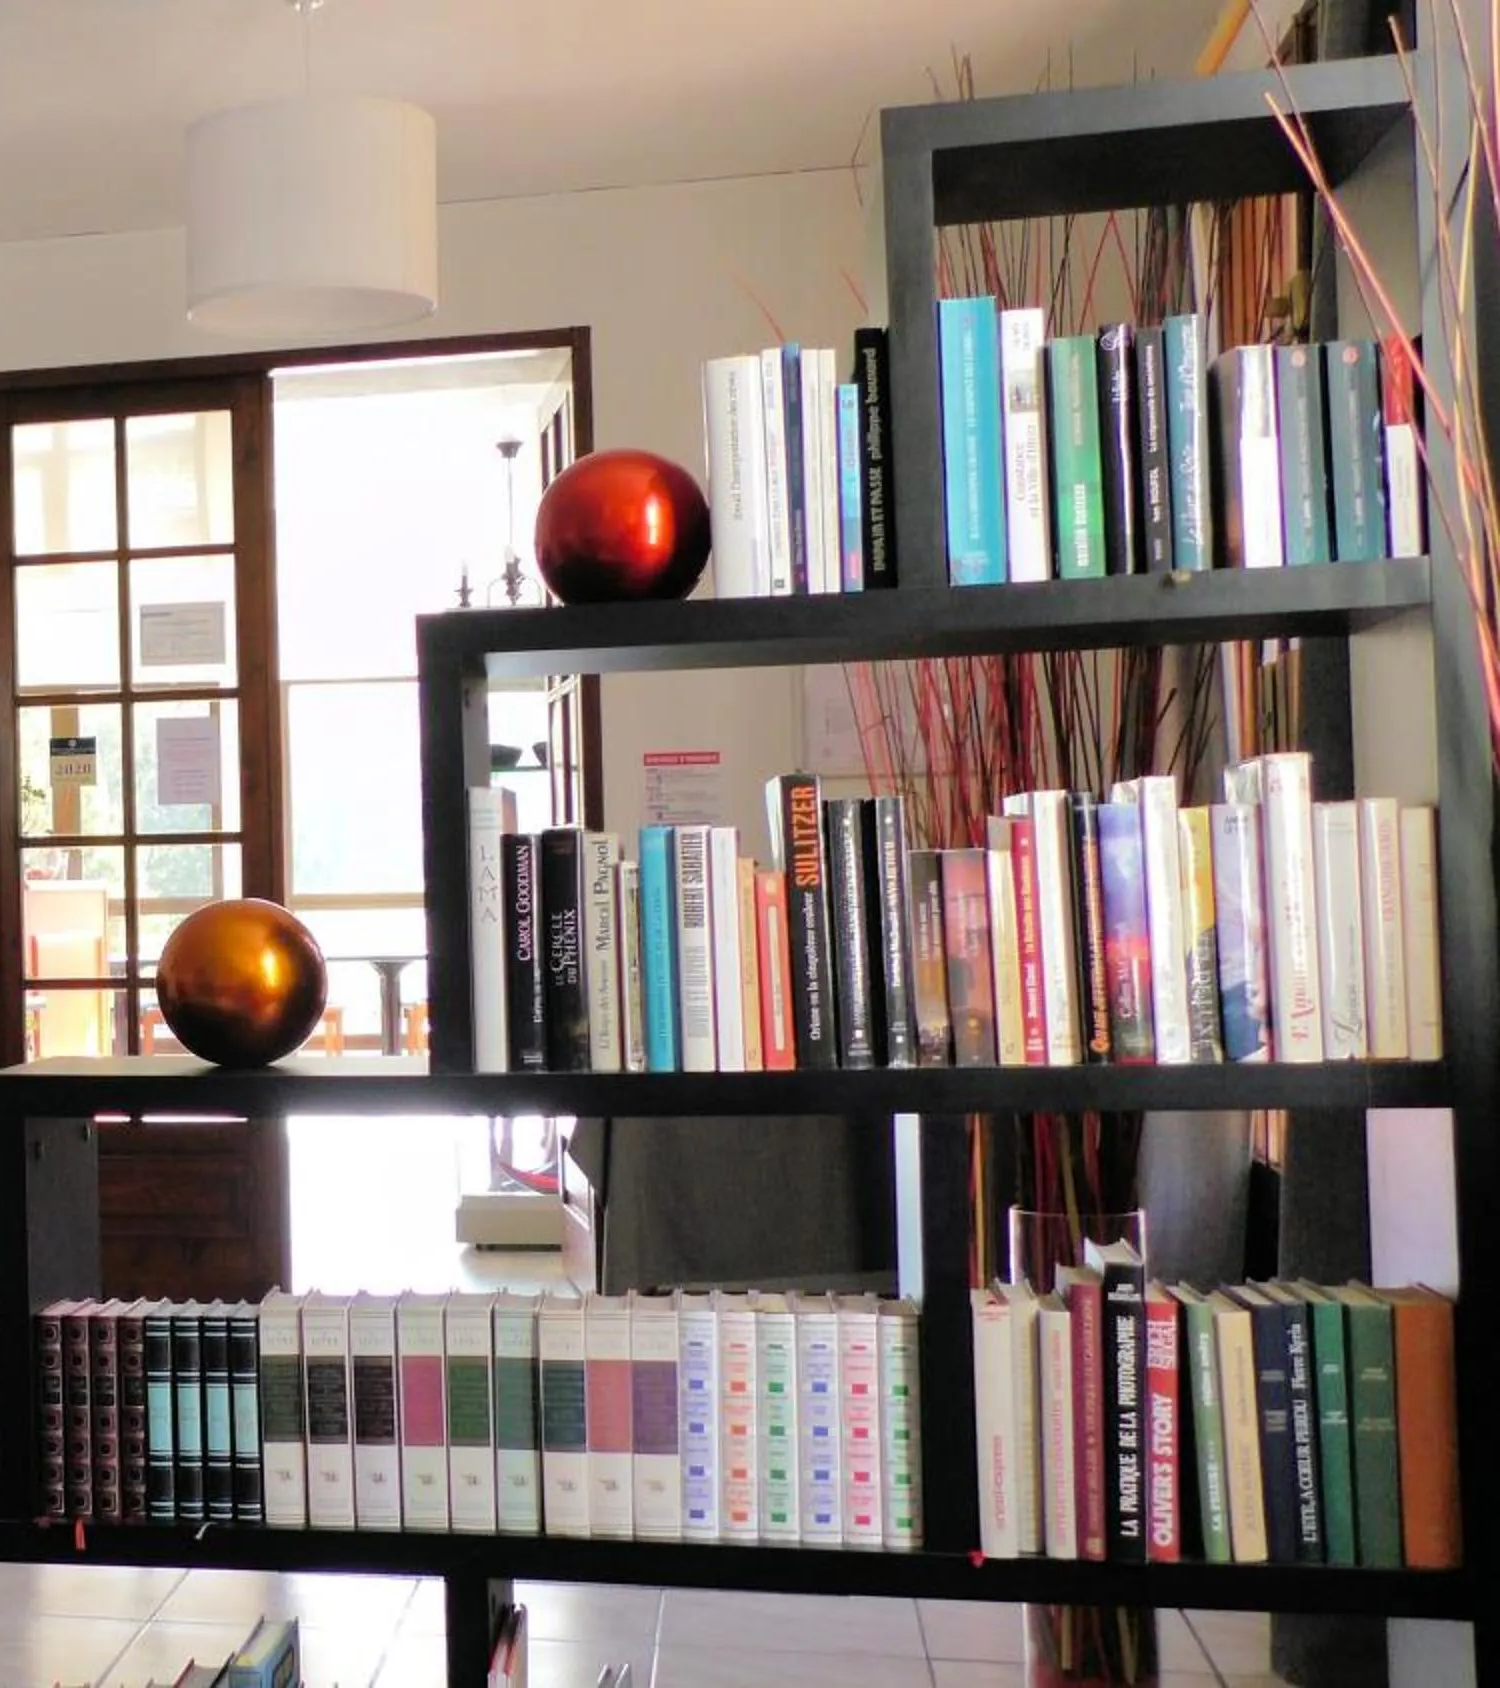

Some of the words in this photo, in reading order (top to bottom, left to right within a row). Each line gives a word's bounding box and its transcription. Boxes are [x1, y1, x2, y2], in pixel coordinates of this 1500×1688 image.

[862, 348, 879, 403] bouvard
[865, 406, 883, 460] philippe
[868, 467, 884, 505] PASSE
[870, 508, 884, 523] ET
[680, 832, 704, 884] SABATIER
[791, 787, 820, 887] SULITZER
[515, 845, 531, 913] GOODMAN
[515, 917, 532, 961] CAROL
[550, 912, 565, 972] CERCLE
[1116, 1316, 1137, 1406] PHOTOGRAPHIE
[1291, 1356, 1307, 1389] Pierre
[1118, 1412, 1136, 1429] LA
[1118, 1432, 1137, 1448] DE
[1151, 1393, 1172, 1457] STORY
[1292, 1400, 1309, 1443] PERDU
[1118, 1454, 1141, 1513] PRATIQUE
[1120, 1520, 1139, 1537] LA
